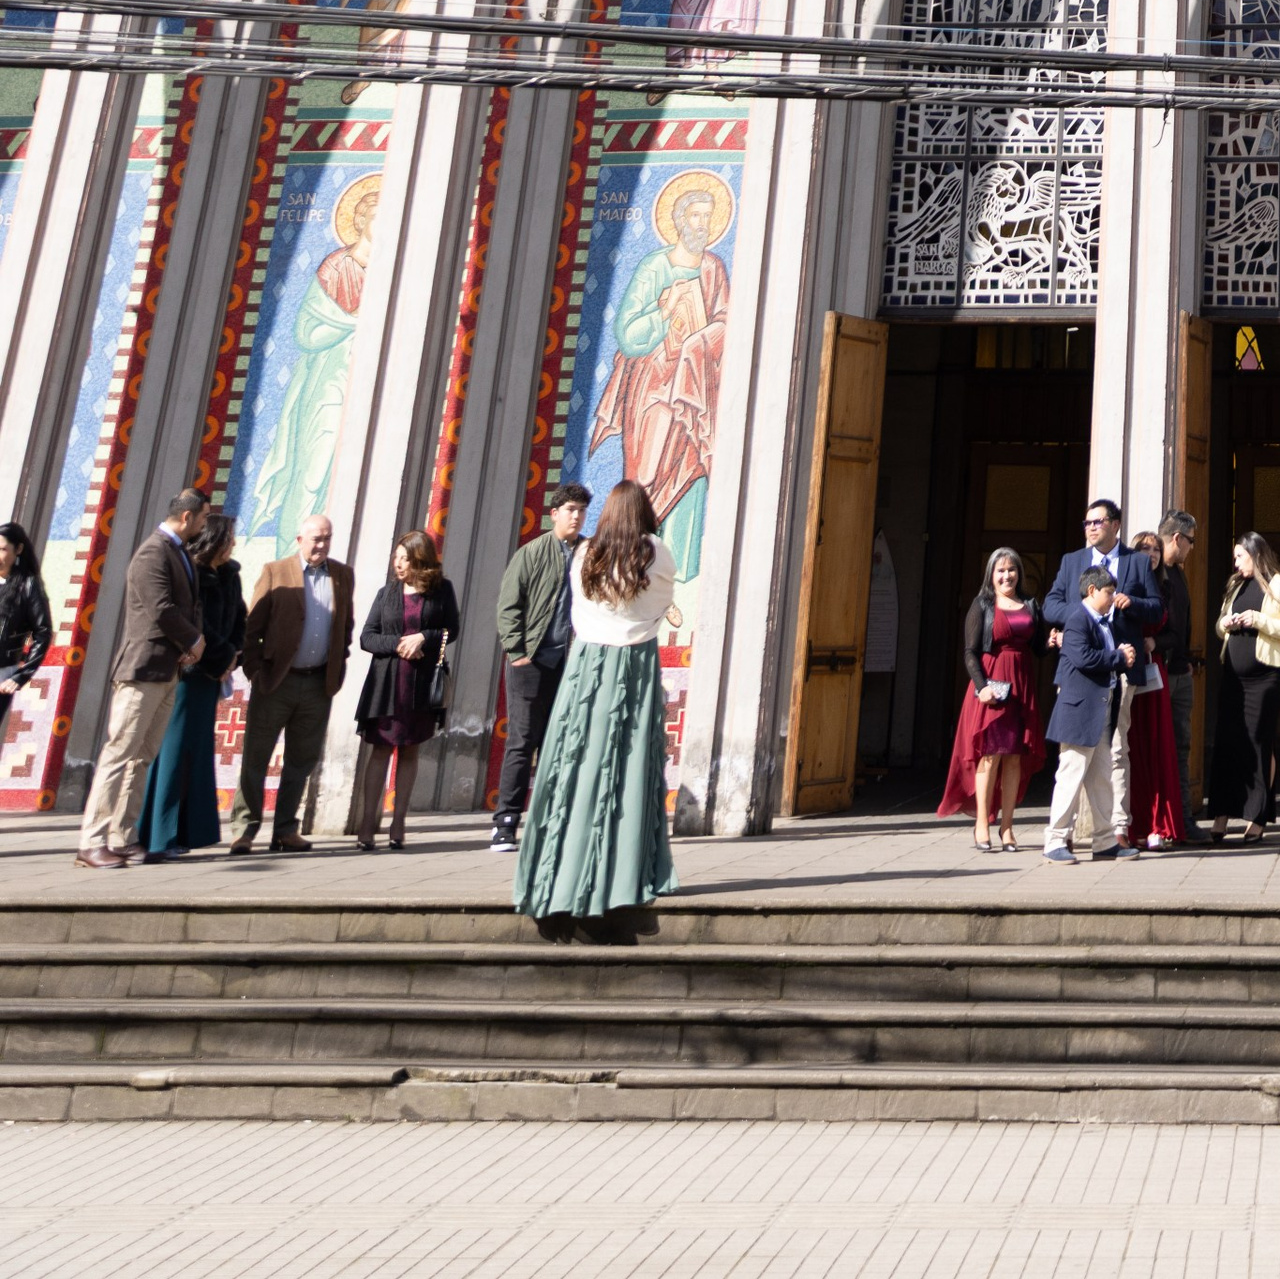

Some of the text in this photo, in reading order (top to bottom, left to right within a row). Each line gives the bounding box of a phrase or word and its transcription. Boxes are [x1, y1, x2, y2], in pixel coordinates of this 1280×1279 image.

[286, 192, 317, 206] SAN
[600, 191, 629, 205] SAN
[280, 209, 326, 222] FELIPE
[599, 207, 643, 221] MATEO
